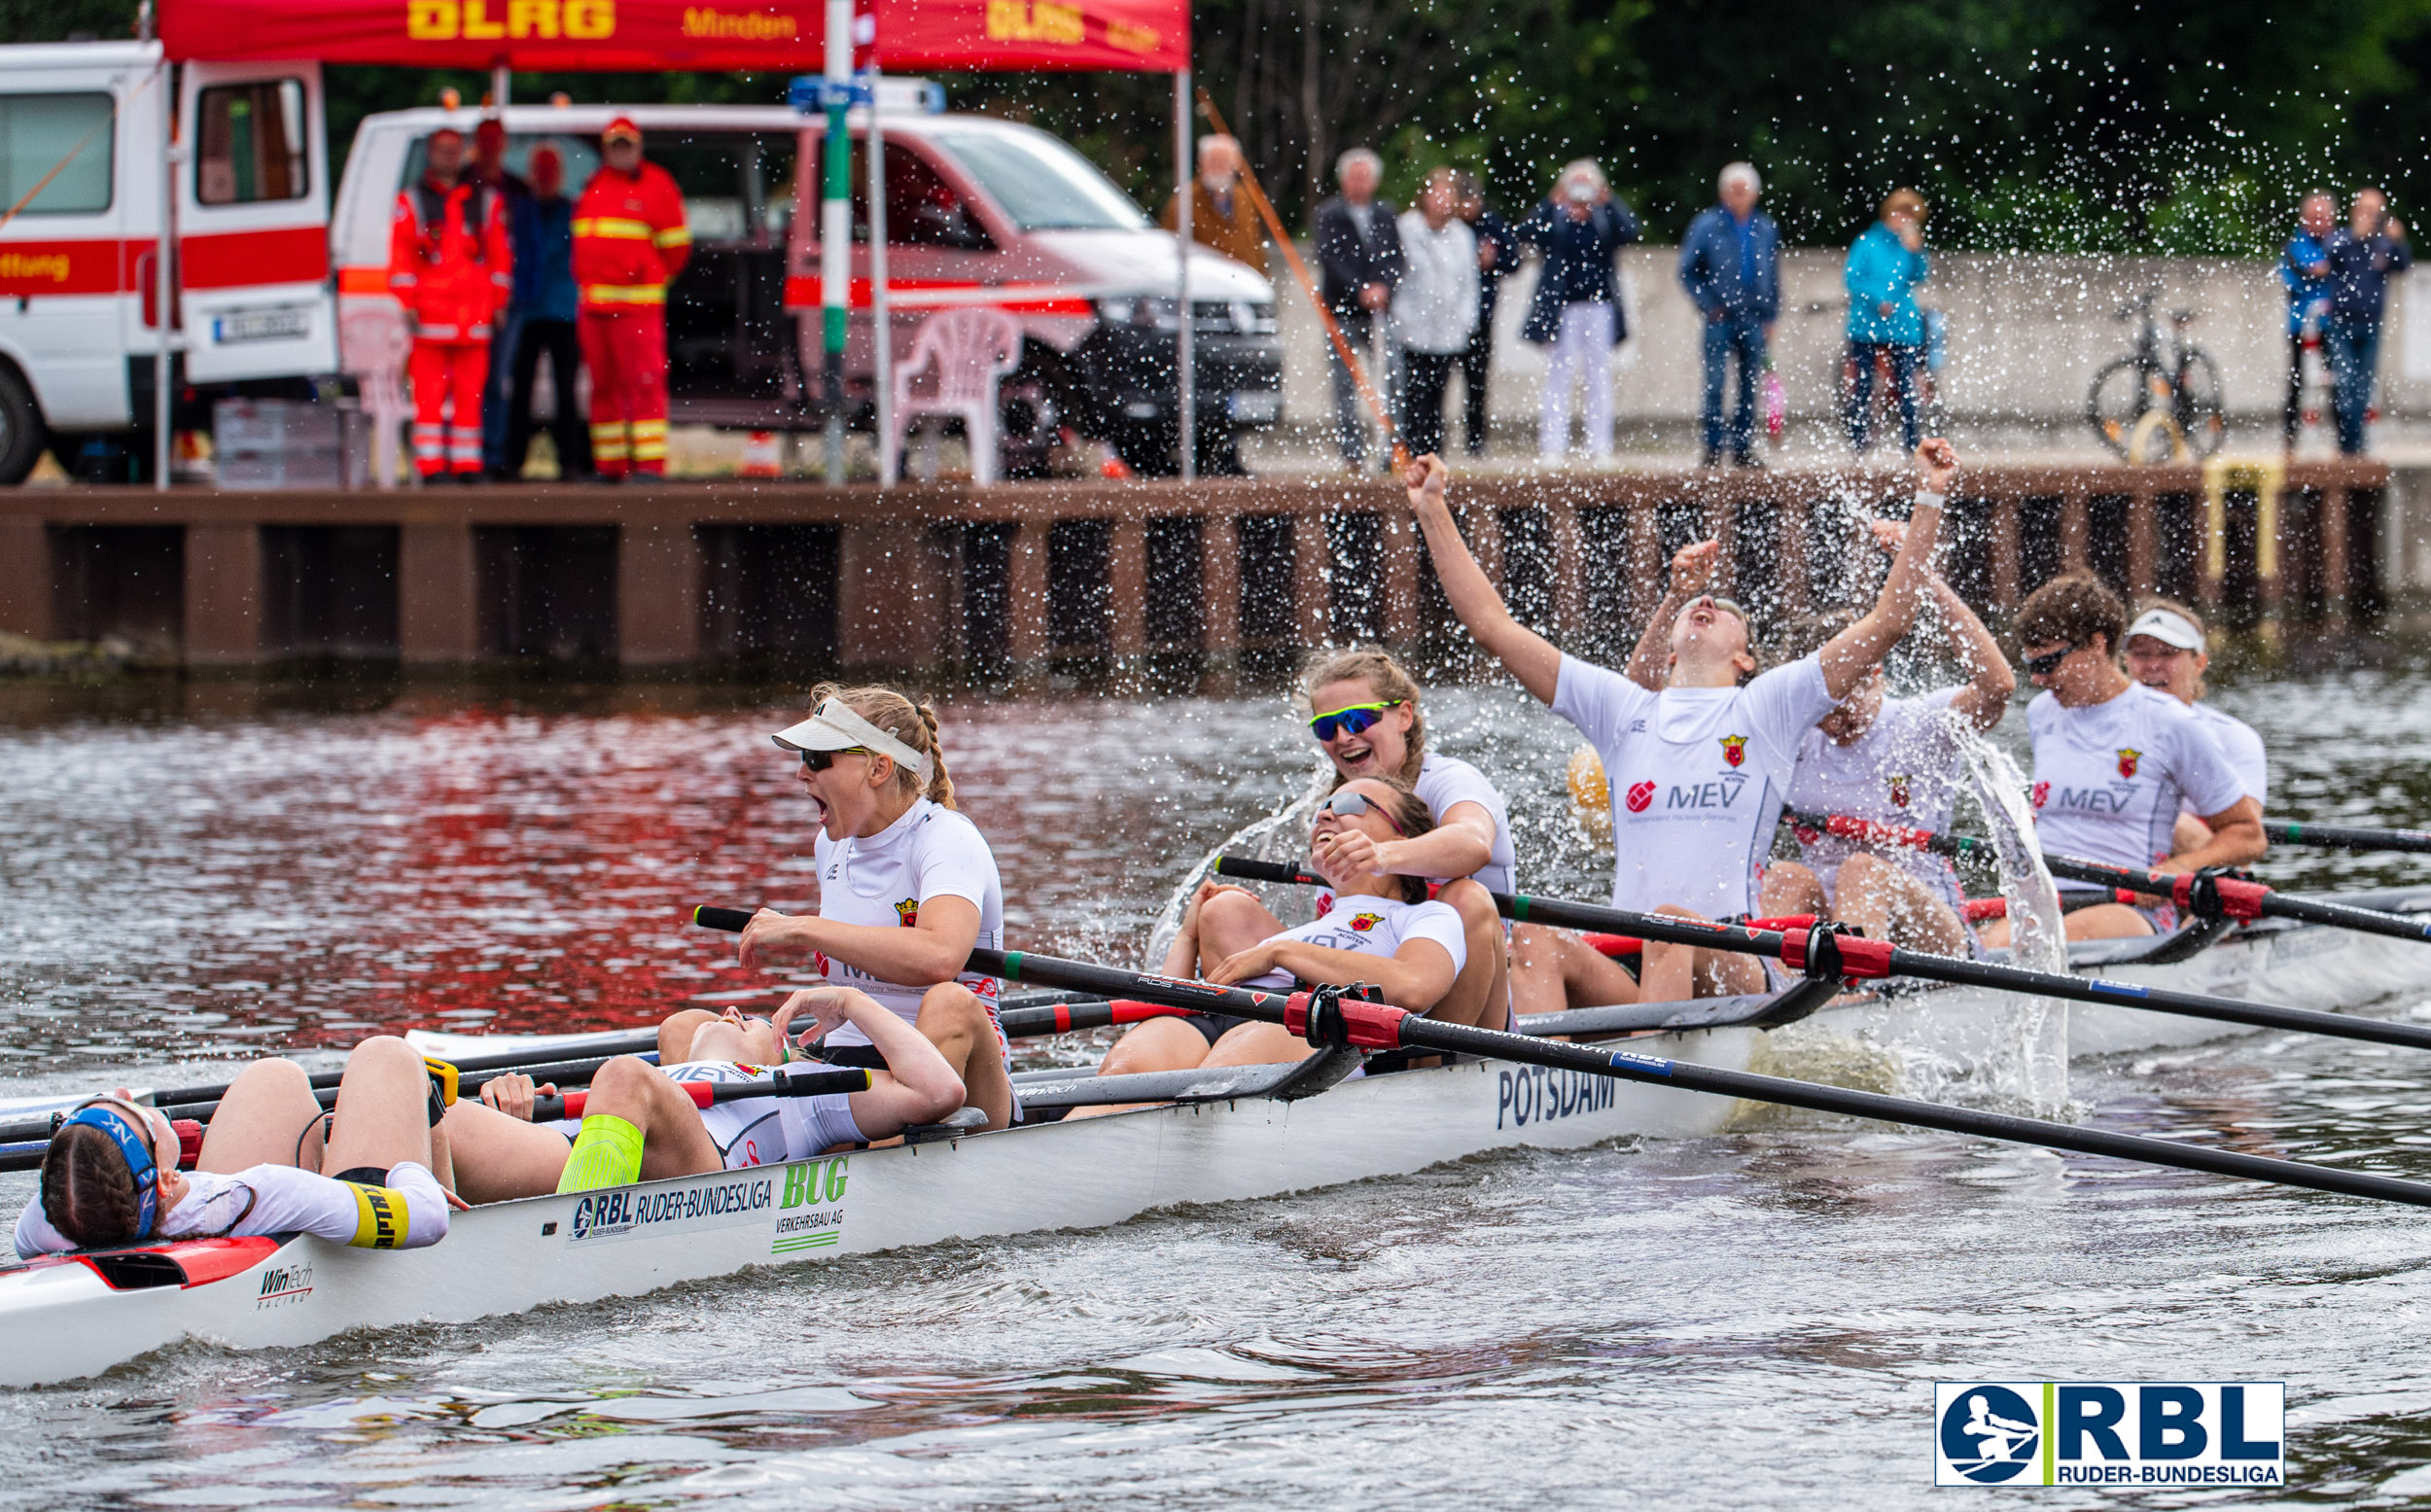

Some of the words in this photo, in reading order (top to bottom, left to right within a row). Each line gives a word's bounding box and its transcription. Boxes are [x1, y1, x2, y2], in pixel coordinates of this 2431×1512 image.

[406, 0, 617, 40] DLRG
[683, 7, 797, 40] Minden
[0, 253, 70, 283] ttung
[1666, 782, 1743, 809] MEV
[2060, 787, 2135, 814] MEV
[1337, 933, 1364, 946] ACHTER
[1497, 1065, 1614, 1130] POTSDAM
[780, 1155, 850, 1210] BUG
[593, 1192, 632, 1227] RBL
[635, 1179, 771, 1225] RUDER-BUNDESLIGA
[776, 1212, 830, 1234] VERKEHRSBAU
[830, 1209, 844, 1225] AG
[261, 1261, 313, 1293] WinTech
[257, 1292, 305, 1311] RACING
